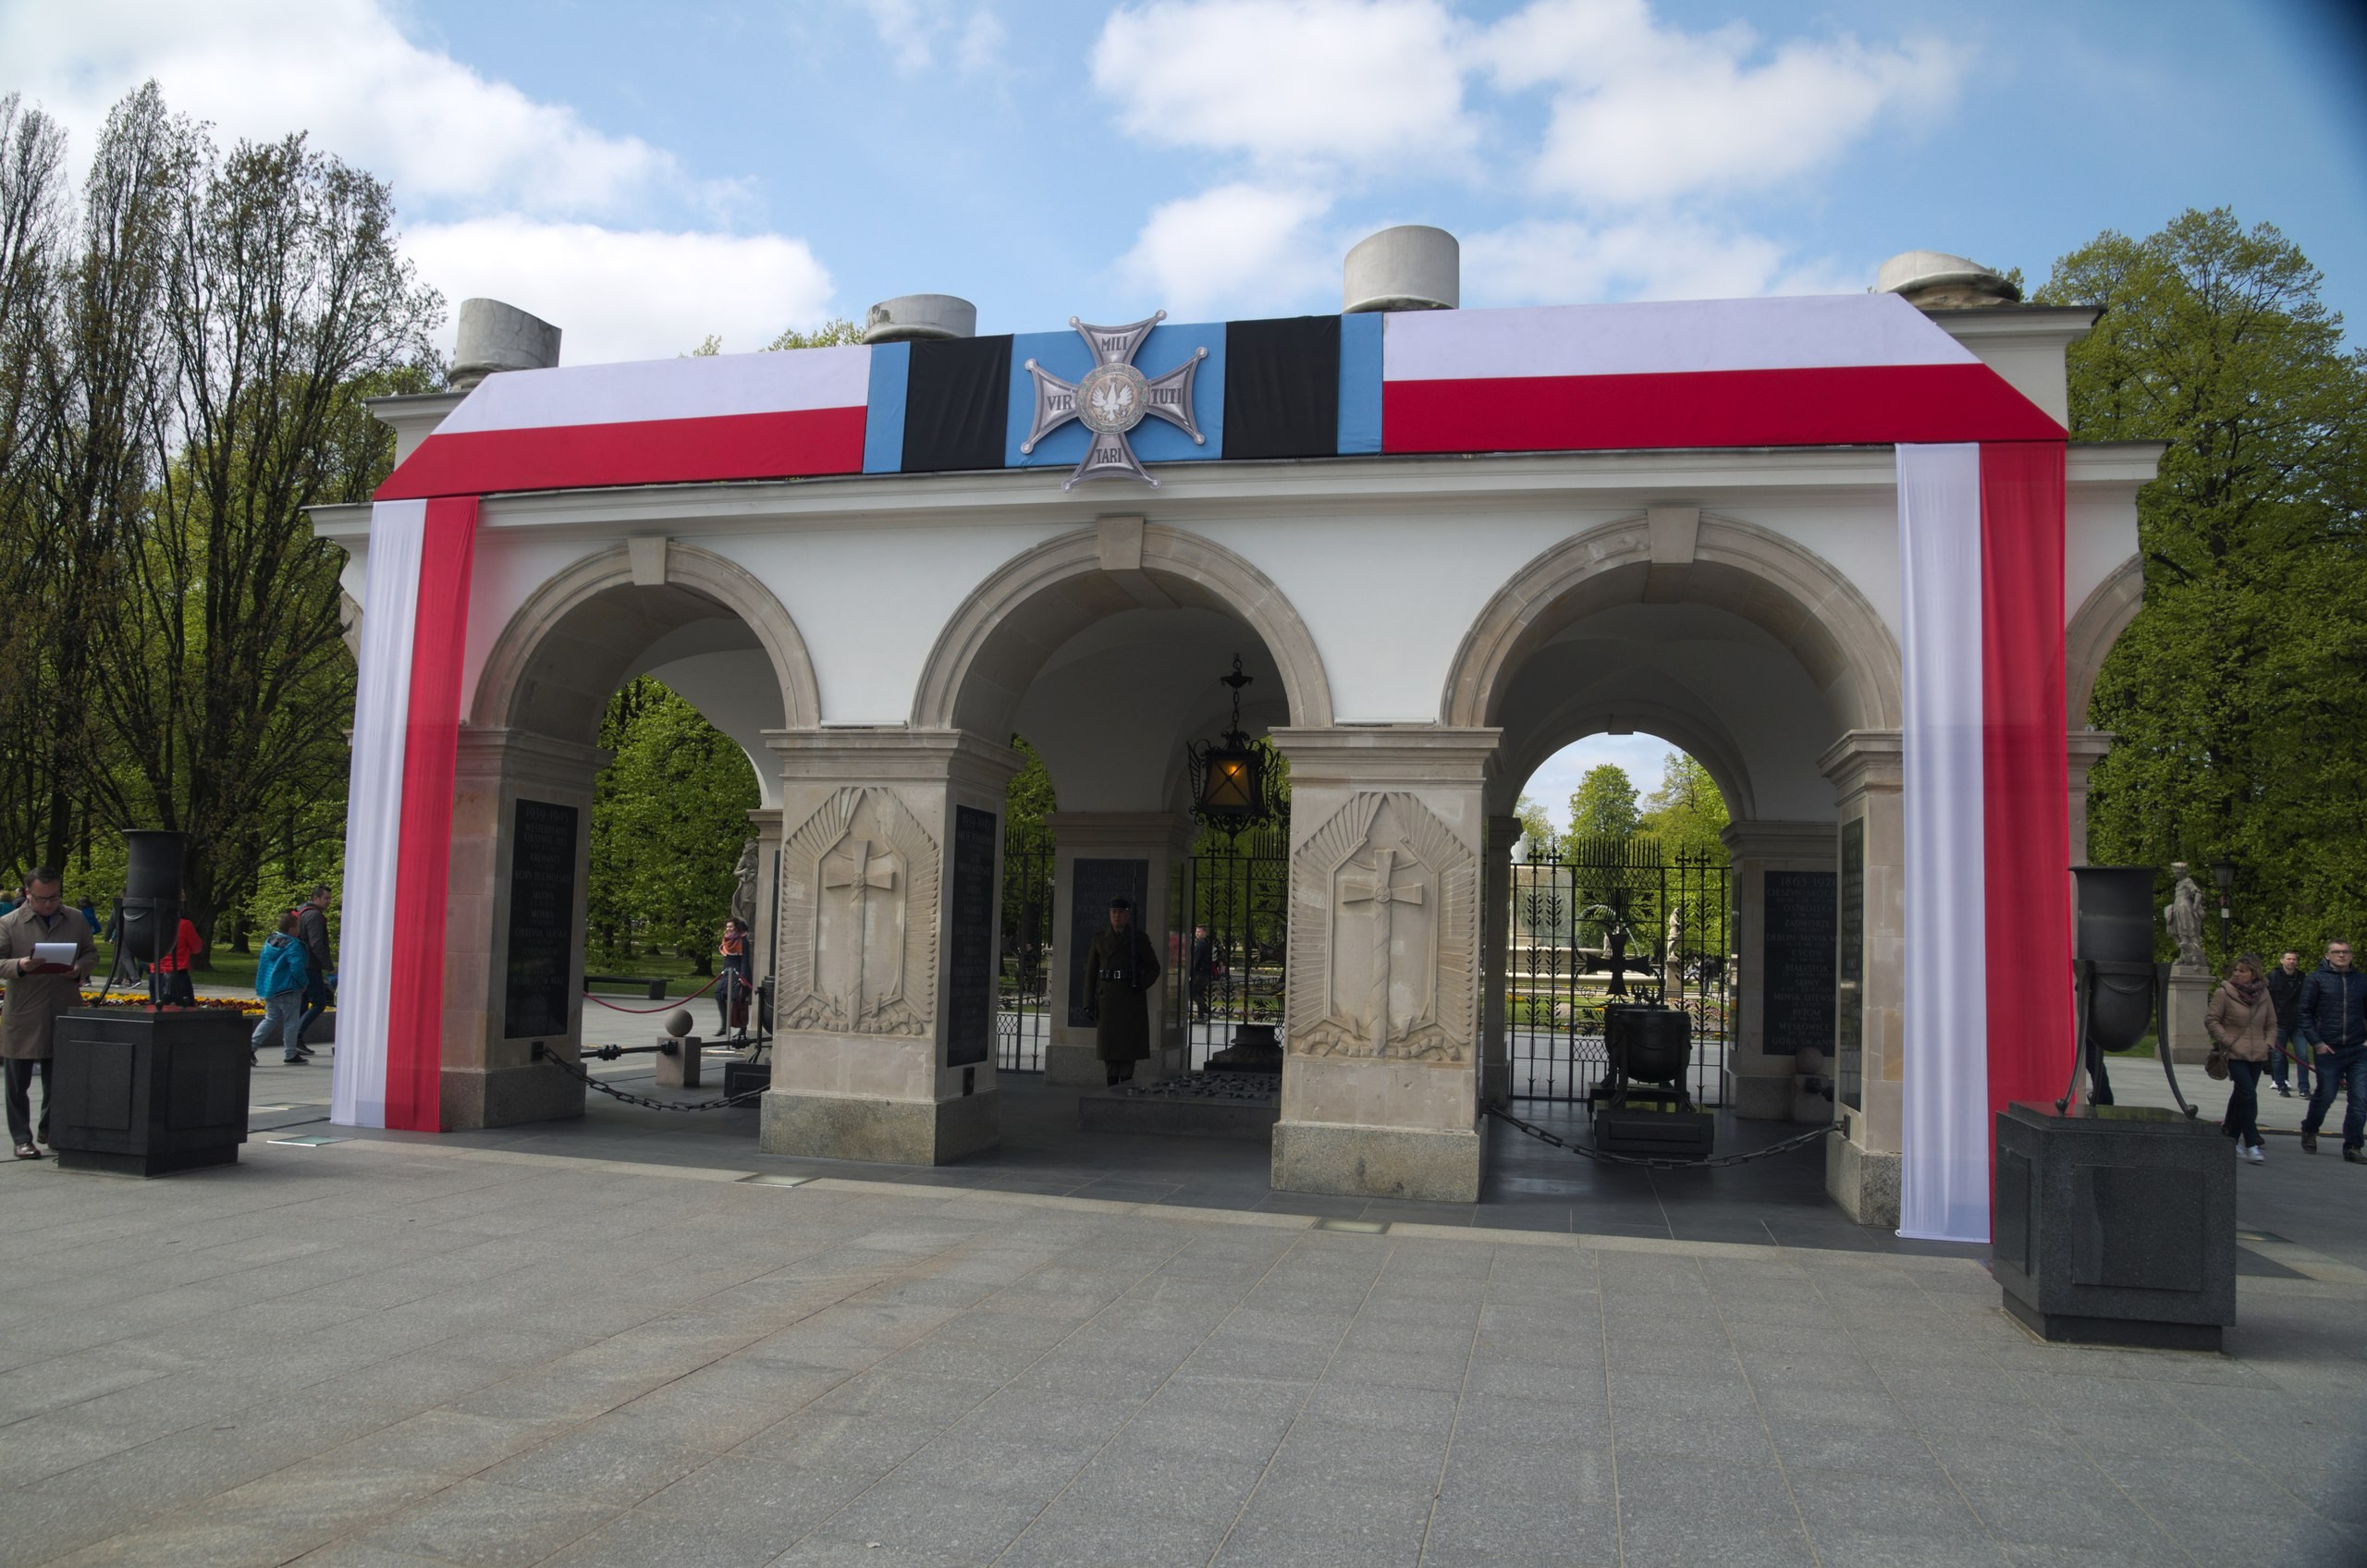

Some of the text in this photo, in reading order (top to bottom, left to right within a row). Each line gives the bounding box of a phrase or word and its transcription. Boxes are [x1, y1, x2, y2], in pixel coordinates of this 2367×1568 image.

[1101, 336, 1128, 352] MILI
[1046, 387, 1183, 411] VIR TUTI
[1095, 447, 1122, 464] TARI
[1781, 876, 1836, 888] 1863-1921
[1766, 888, 1836, 897] CIESZYN-SKOCZ
[1784, 918, 1830, 927] ZADWORZE
